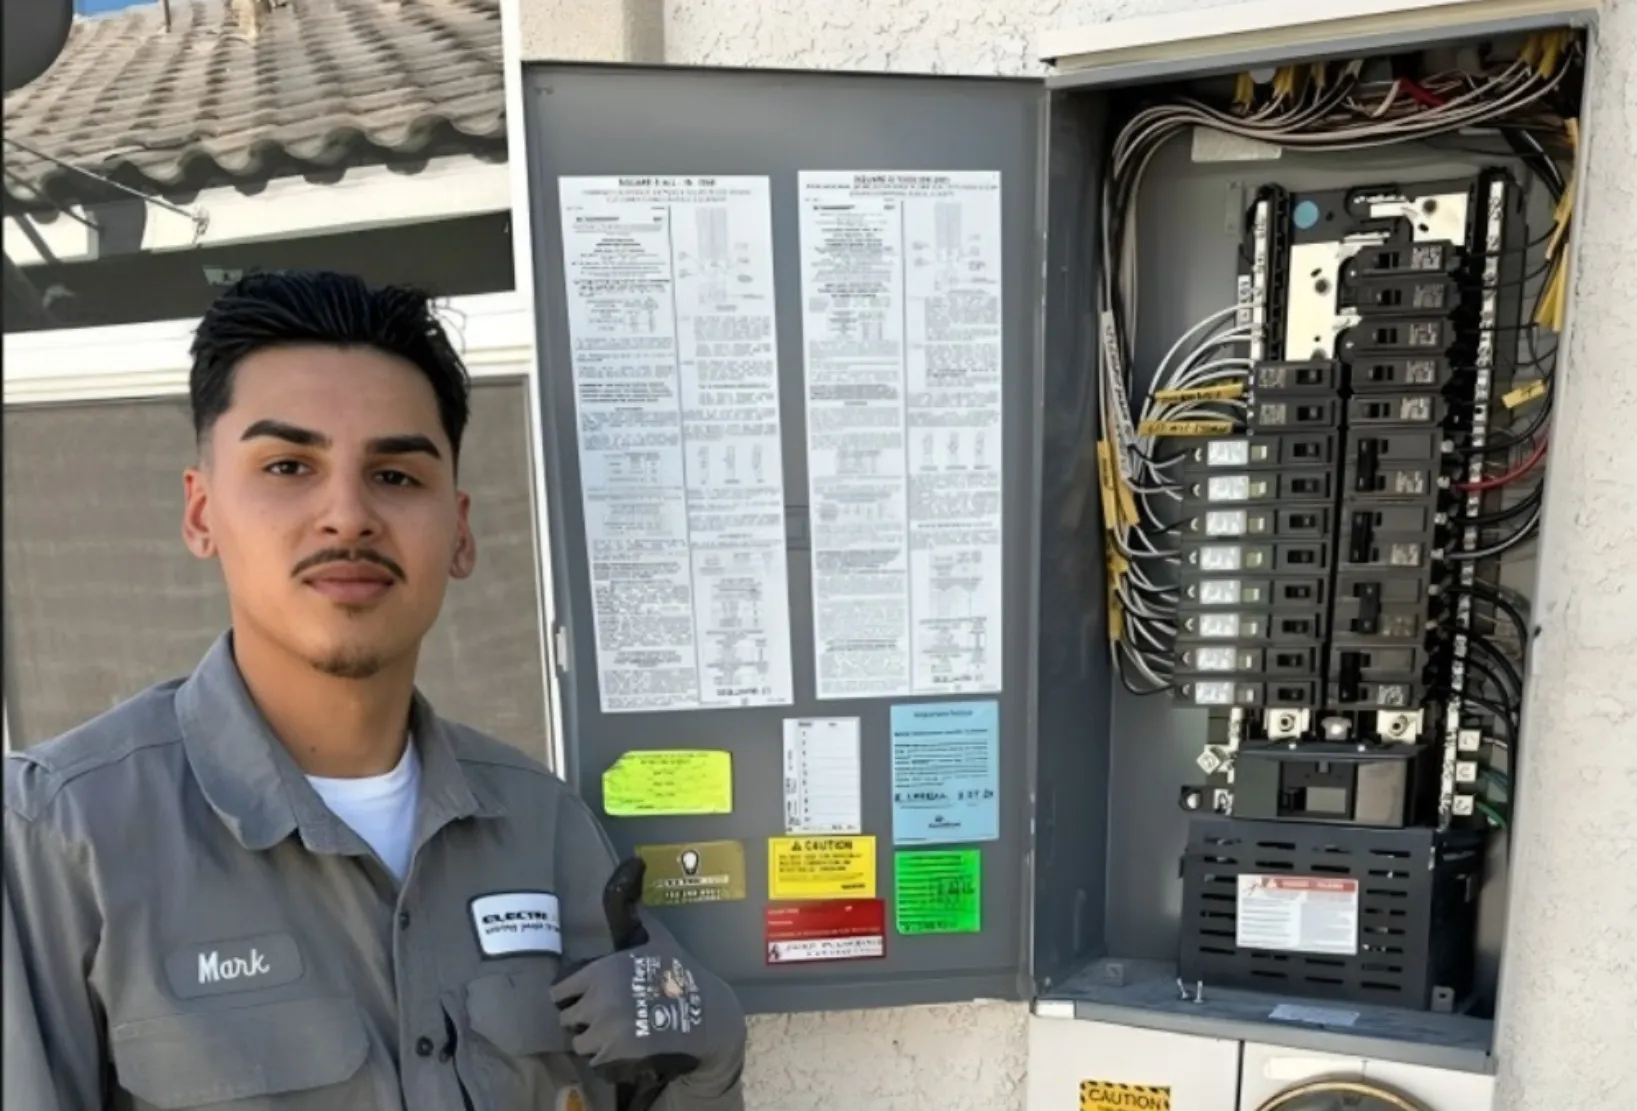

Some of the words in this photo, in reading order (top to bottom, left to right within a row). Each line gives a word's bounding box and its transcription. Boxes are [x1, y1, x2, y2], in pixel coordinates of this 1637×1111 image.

[805, 840, 852, 851] CAUTION
[199, 948, 270, 985] Mark
[1088, 1087, 1162, 1110] CAUTION
